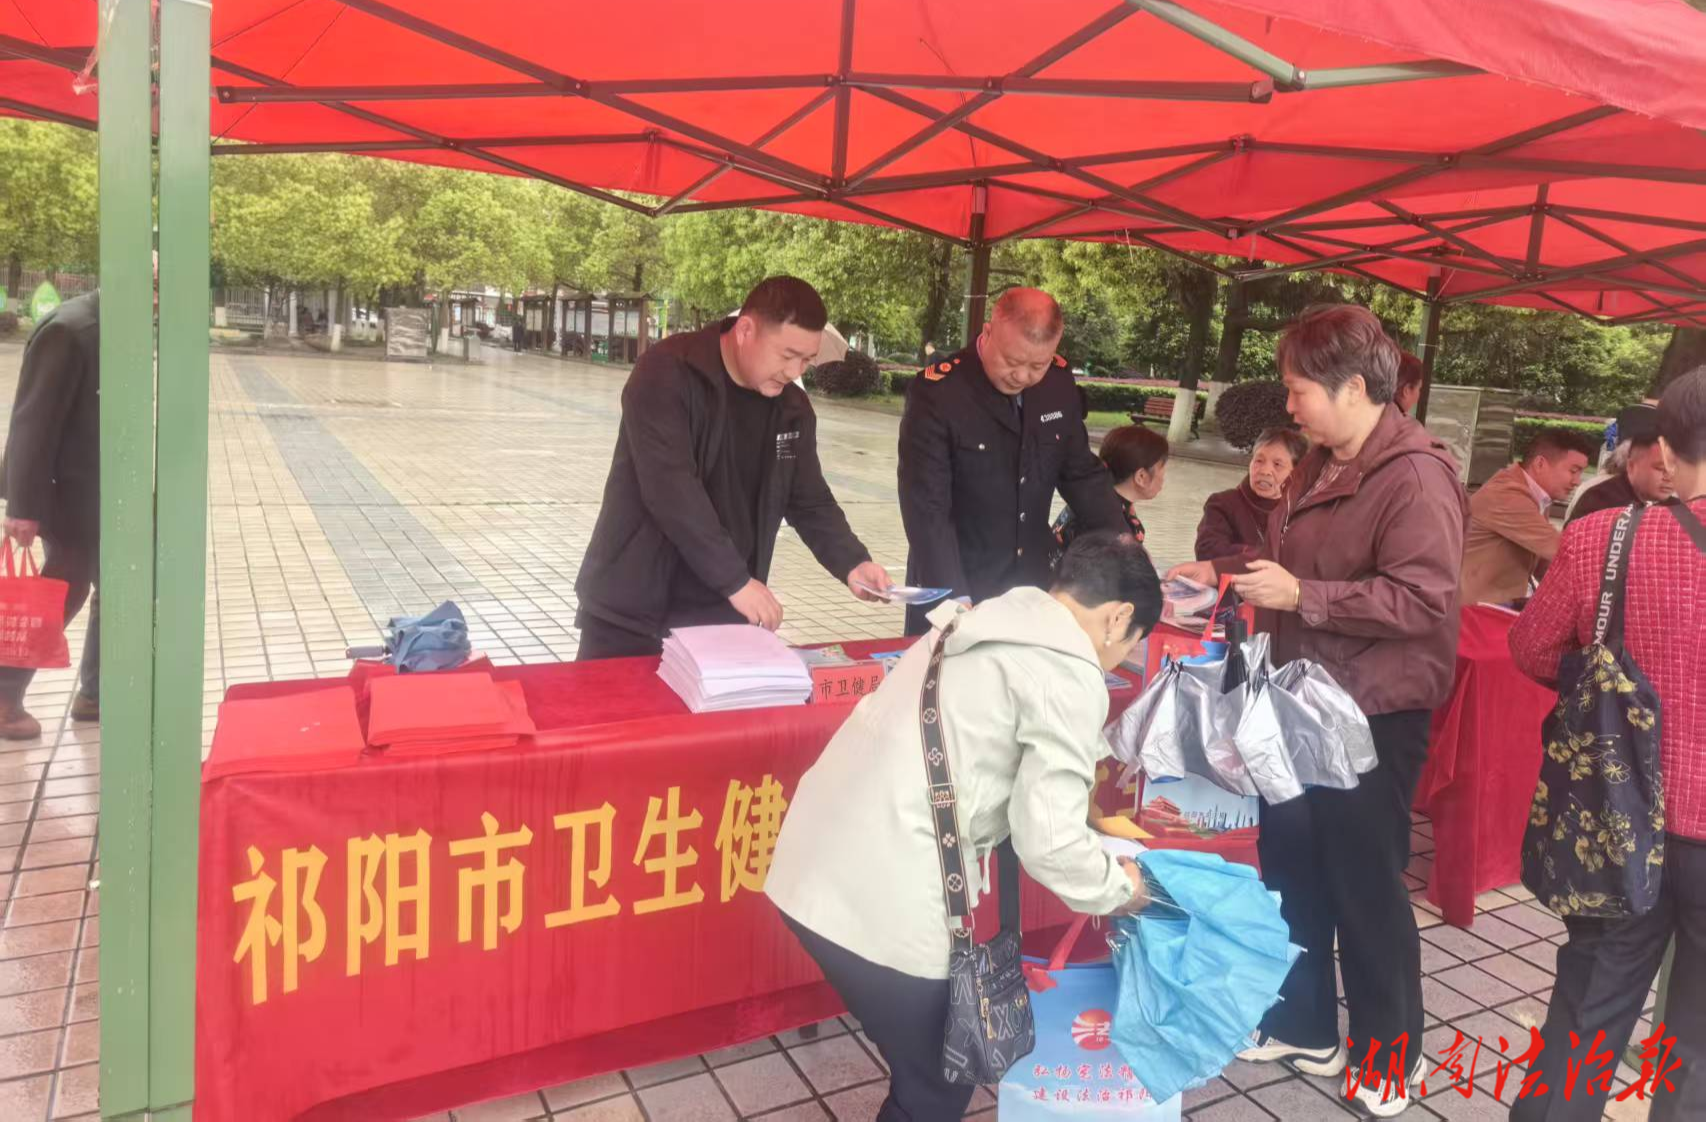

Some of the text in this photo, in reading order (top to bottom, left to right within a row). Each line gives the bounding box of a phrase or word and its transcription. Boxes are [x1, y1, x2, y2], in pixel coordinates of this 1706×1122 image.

[1605, 517, 1630, 581] UNDER
[819, 675, 881, 700] 市卫健局
[232, 774, 787, 1005] 祁阳市卫生健
